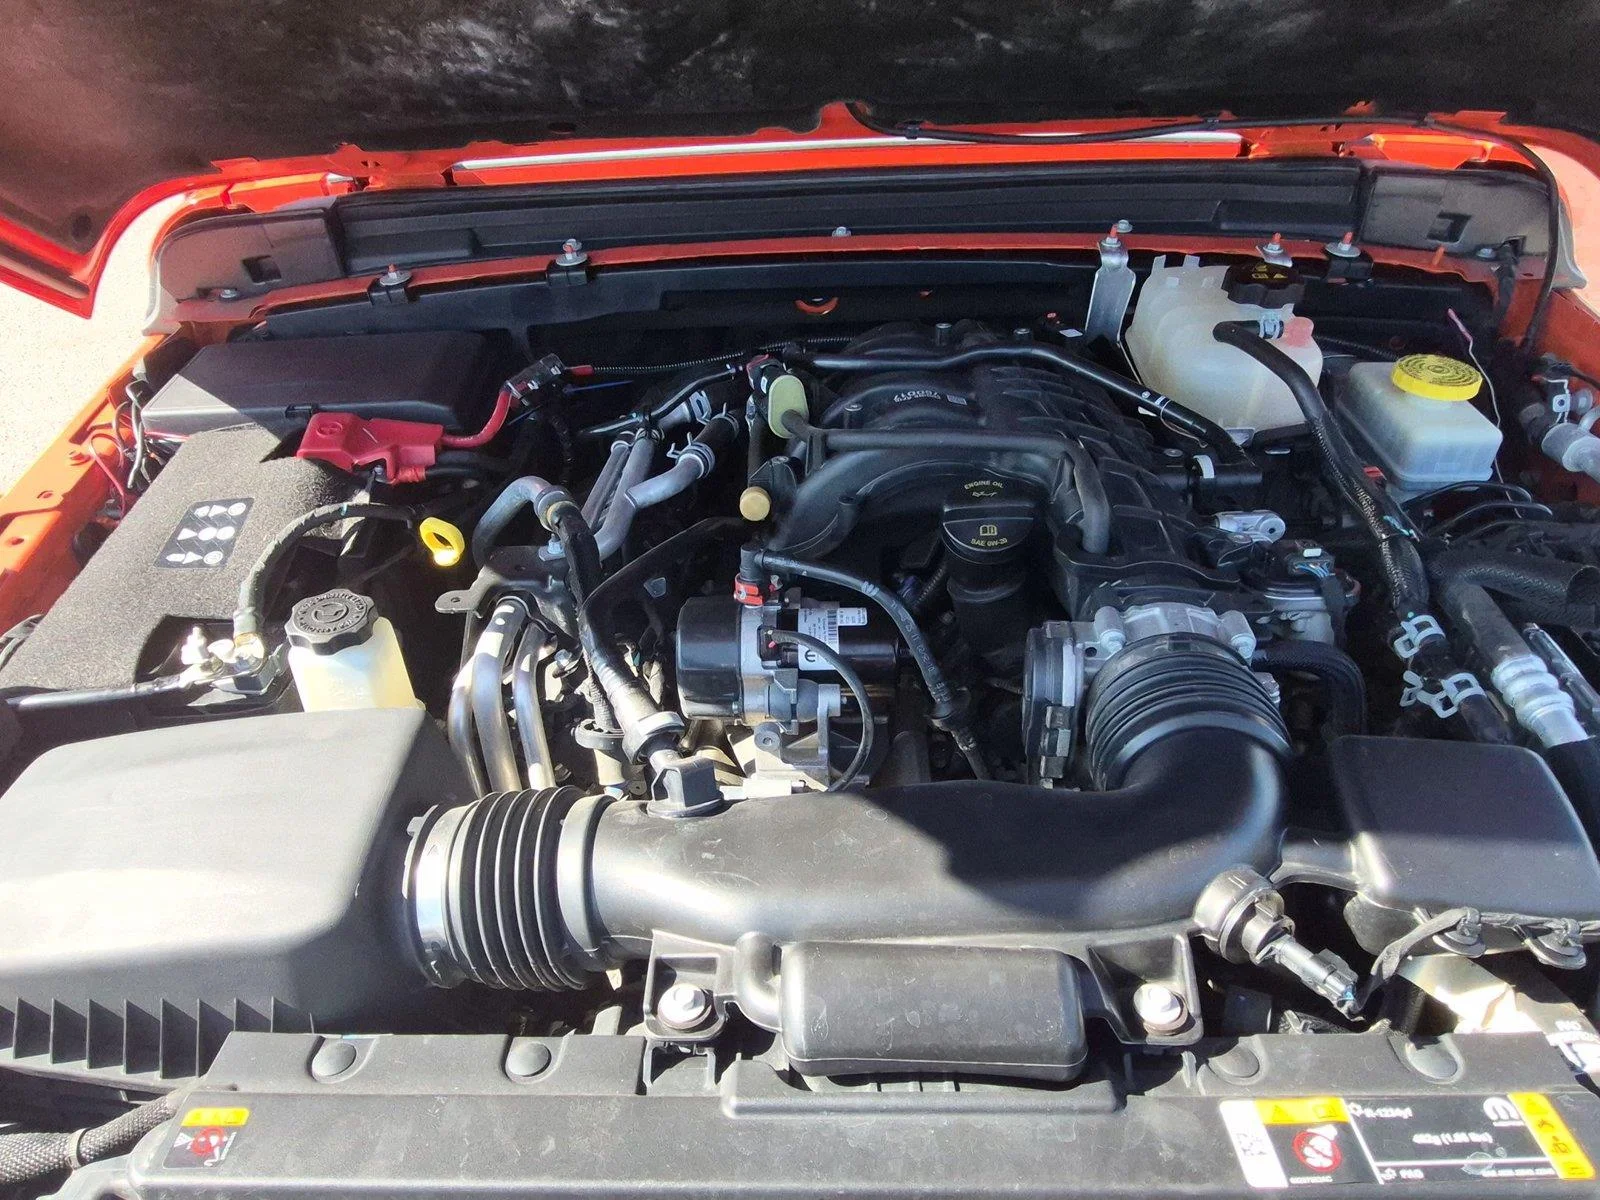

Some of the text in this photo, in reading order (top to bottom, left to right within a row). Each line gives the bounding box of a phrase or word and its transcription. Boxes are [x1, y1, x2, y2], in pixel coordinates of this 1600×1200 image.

[964, 481, 991, 490] ENGINE
[970, 537, 1008, 547] SAE 0W-20
